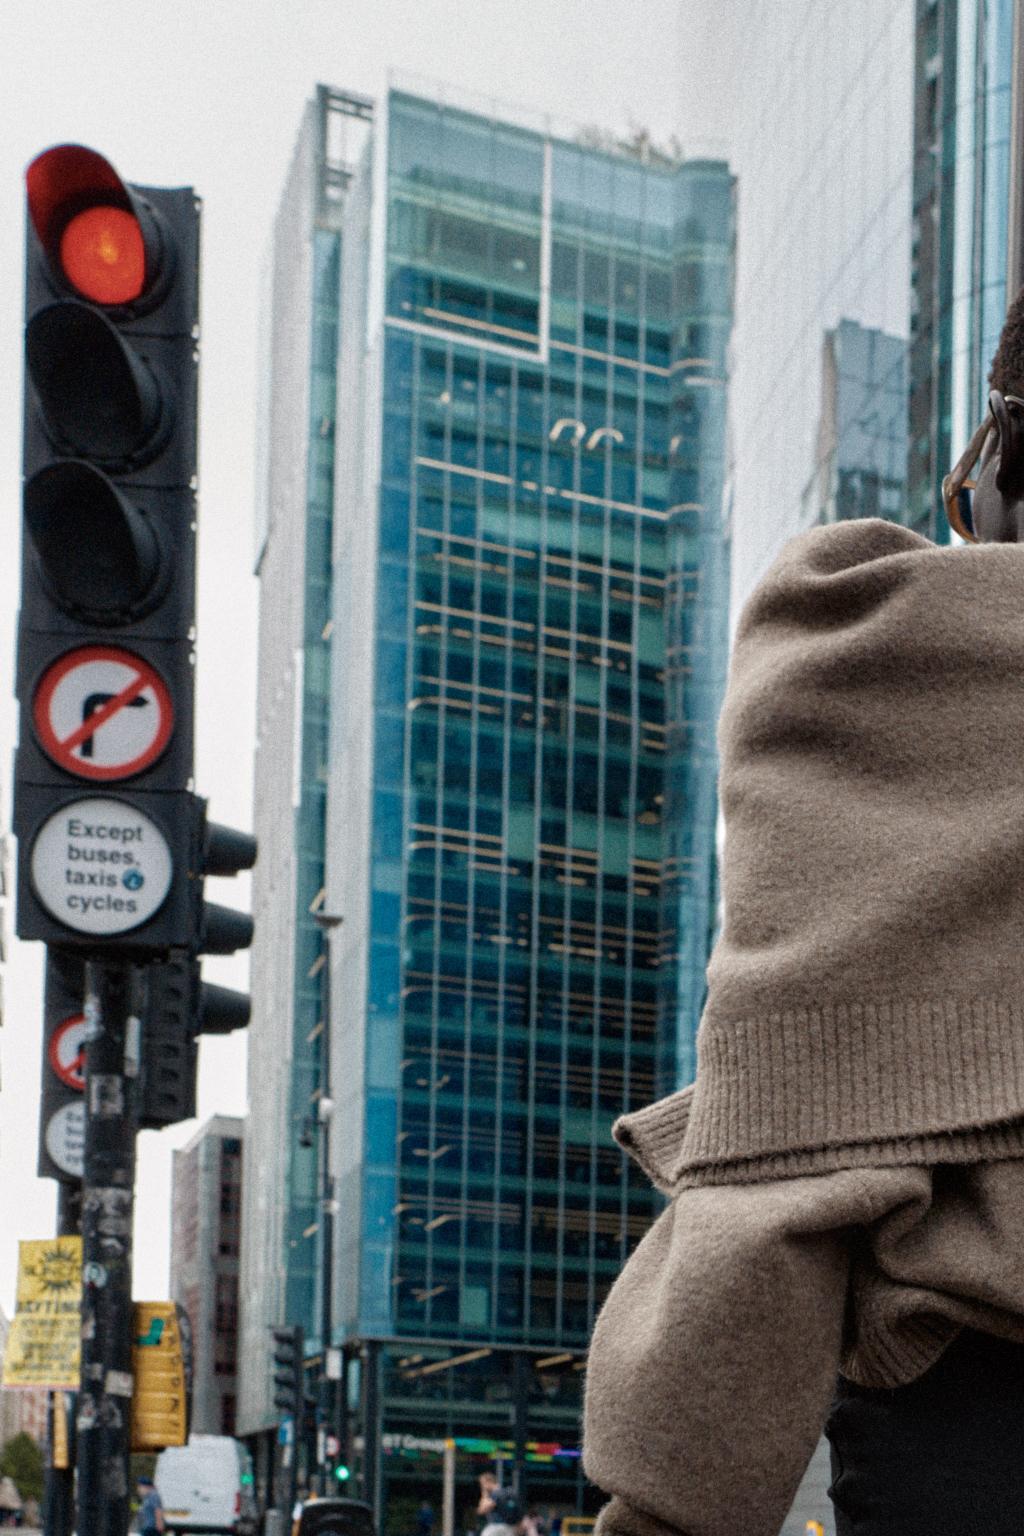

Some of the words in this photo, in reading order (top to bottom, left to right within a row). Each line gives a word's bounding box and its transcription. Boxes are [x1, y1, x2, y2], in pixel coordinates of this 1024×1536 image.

[68, 819, 142, 843] Except
[66, 869, 117, 887] taxis
[67, 894, 137, 913] cycles
